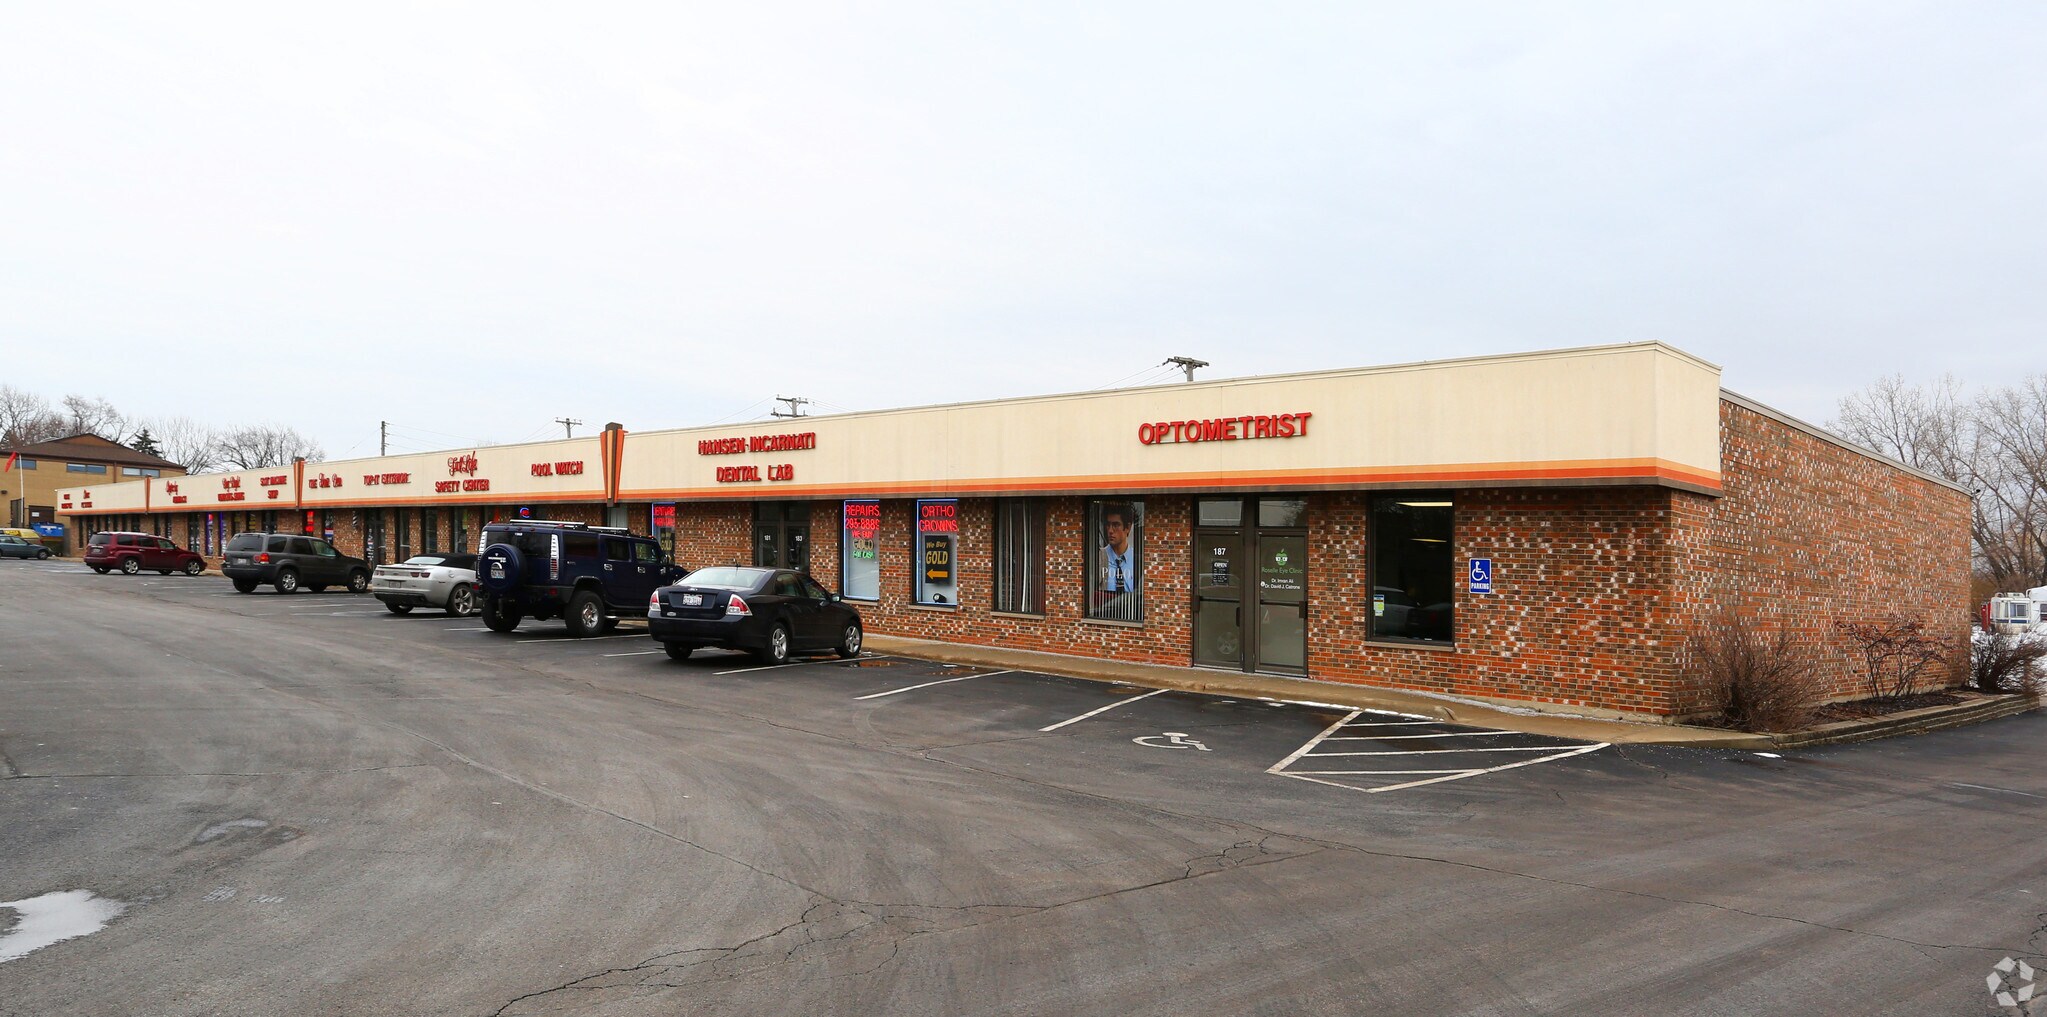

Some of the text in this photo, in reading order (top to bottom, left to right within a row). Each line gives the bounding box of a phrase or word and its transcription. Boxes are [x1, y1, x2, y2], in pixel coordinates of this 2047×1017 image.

[1138, 412, 1312, 445] OPTOMETRIST
[531, 461, 583, 477] POOL WATCH
[716, 464, 794, 482] DENTAL LAB
[435, 479, 490, 493] SAFETY CENTER
[846, 504, 881, 517] REPAIRS
[921, 505, 955, 518] ORTHO
[919, 520, 959, 532] CROWNS
[936, 541, 947, 549] Buy
[1213, 547, 1226, 556] 187
[926, 551, 948, 565] GOLD
